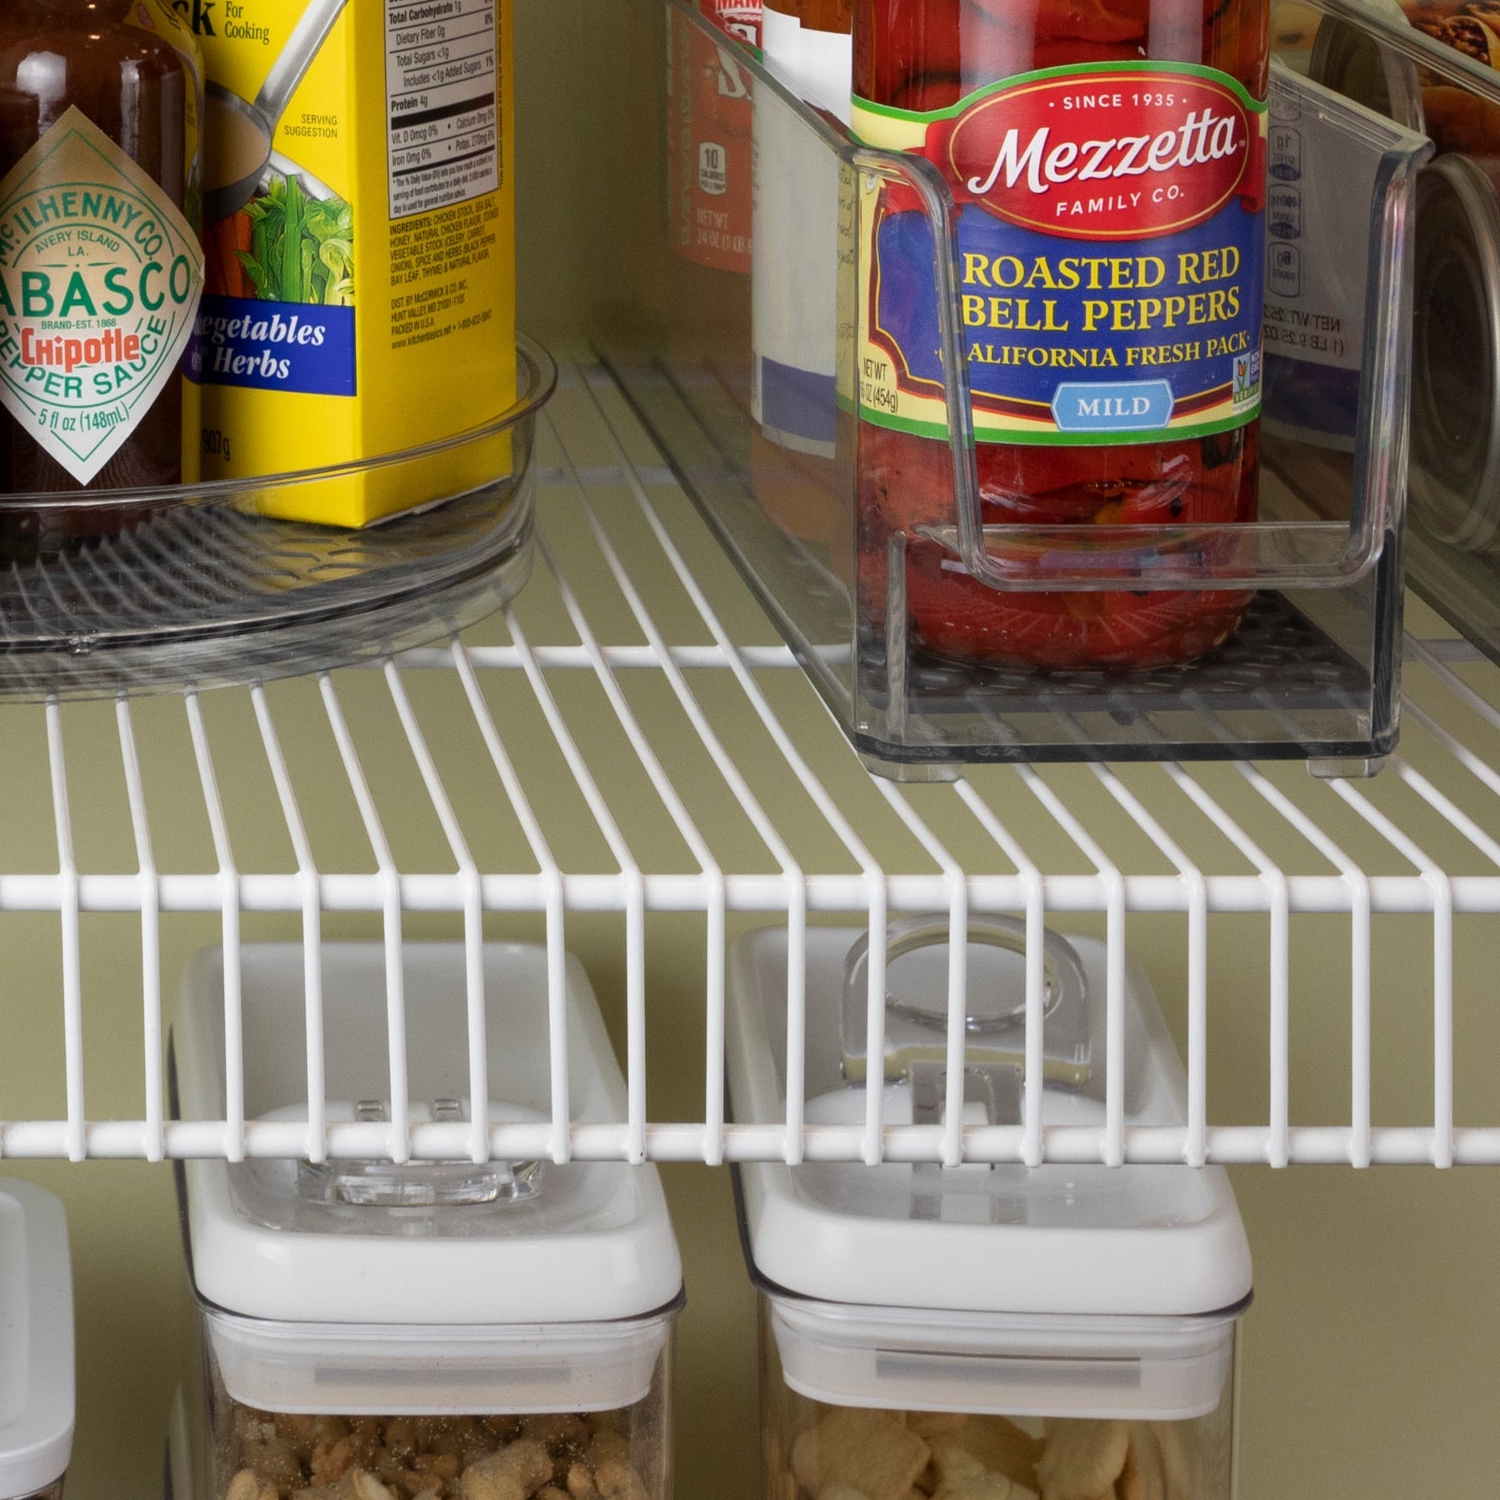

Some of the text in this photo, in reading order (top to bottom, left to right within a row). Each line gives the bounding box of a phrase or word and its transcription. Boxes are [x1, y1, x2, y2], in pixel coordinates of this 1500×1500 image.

[225, 1, 244, 18] For
[389, 3, 453, 25] Total Carbohydrate
[225, 21, 269, 45] Cooking
[396, 26, 436, 47] Dietary Fiber
[414, 52, 436, 66] Sugars
[391, 99, 418, 112] Protein
[1063, 93, 1174, 109] SINCE 1935
[301, 114, 338, 126] SERVING
[284, 126, 338, 139] SUGGESTION
[705, 148, 718, 169] 10
[967, 108, 1237, 194] Mezzetta
[1056, 184, 1184, 216] FAMILY CO.
[35, 230, 121, 254] AVERY ISLAND
[68, 246, 89, 257] LA.
[134, 220, 163, 261] CO.
[963, 246, 1240, 290] ROASTED RED
[962, 286, 1240, 331] BELL PEPPERS
[97, 318, 116, 328] 1868
[201, 314, 325, 346] egetables
[93, 315, 167, 394] SAUCE
[1133, 341, 1200, 368] FRESH
[1206, 330, 1247, 358] PACK
[212, 347, 291, 379] Herbs
[873, 386, 898, 414] (454g)
[1077, 397, 1150, 417] MILD
[38, 400, 130, 432] 5 fl oz (148mL)
